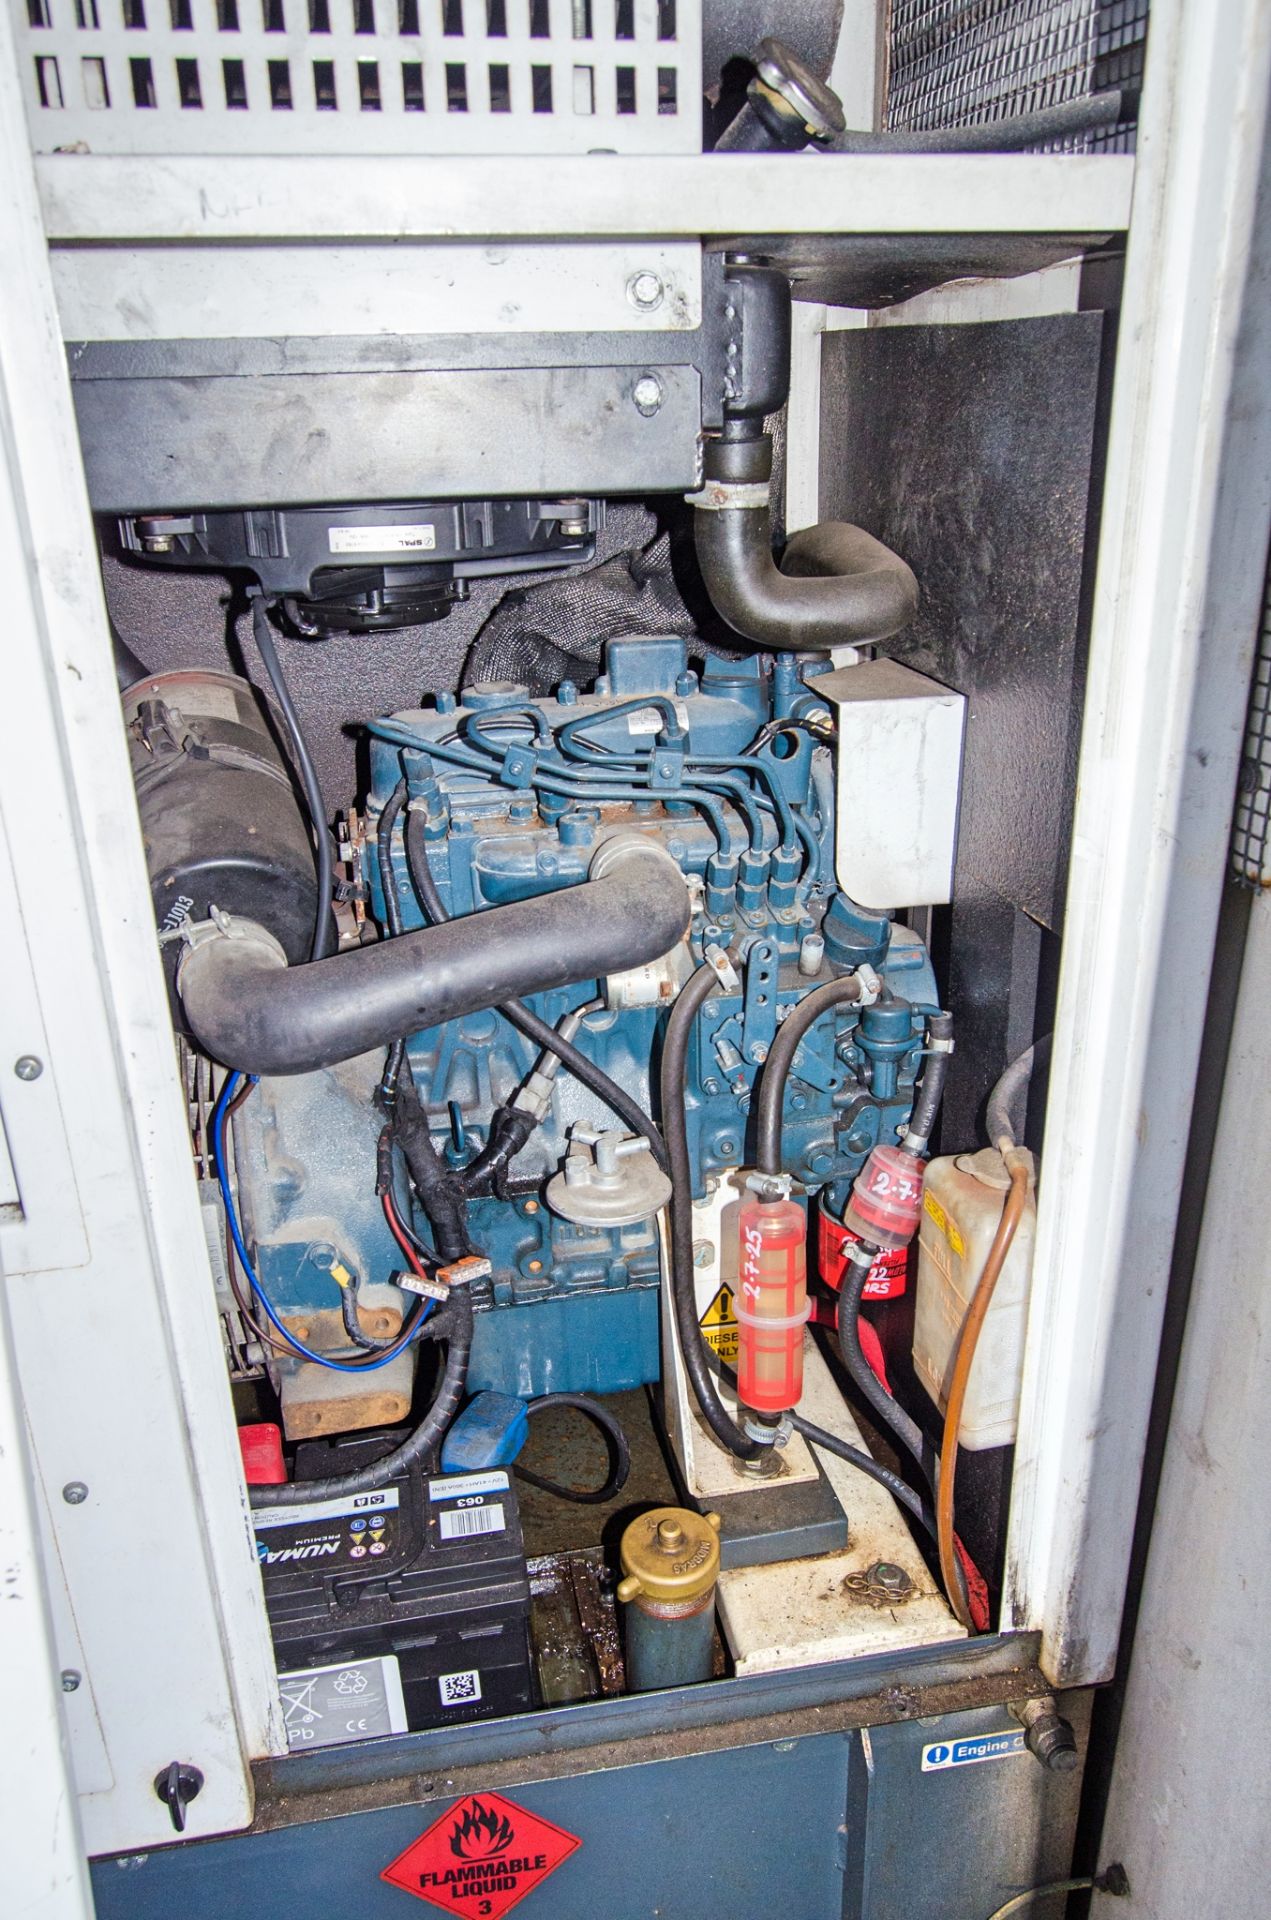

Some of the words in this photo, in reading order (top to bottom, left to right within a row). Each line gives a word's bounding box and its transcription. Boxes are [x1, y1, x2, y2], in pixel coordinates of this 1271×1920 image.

[398, 539, 423, 547] SPAL
[456, 1495, 484, 1508] 063
[295, 1533, 341, 1545] PREMIUM
[346, 1718, 367, 1732] CE
[288, 1728, 315, 1743] Pb
[957, 1741, 1009, 1757] Engine
[419, 1854, 547, 1888] FLAMMABLE
[451, 1876, 517, 1899] LIQUID
[477, 1899, 492, 1915] 3
